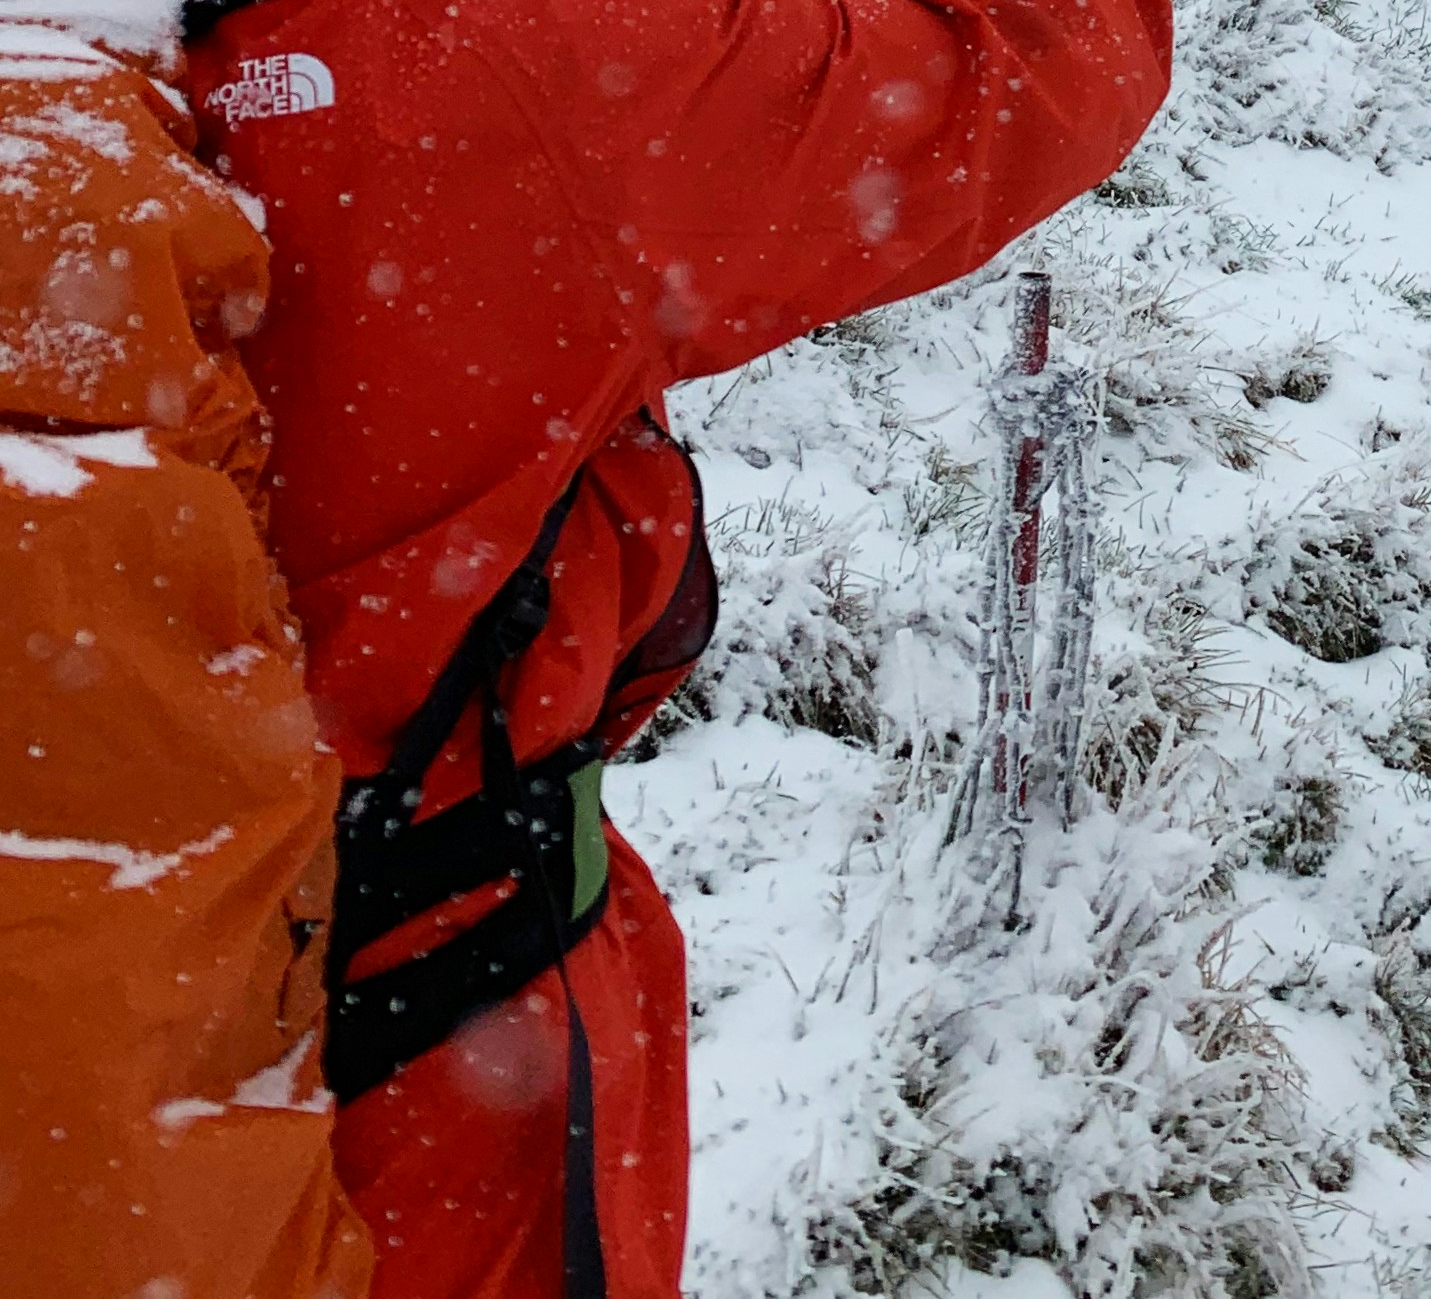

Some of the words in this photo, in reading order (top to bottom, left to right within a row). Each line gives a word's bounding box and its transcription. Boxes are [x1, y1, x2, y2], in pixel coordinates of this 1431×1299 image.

[238, 53, 288, 80] THE
[203, 74, 289, 109] NORTH
[225, 93, 289, 124] FACE
